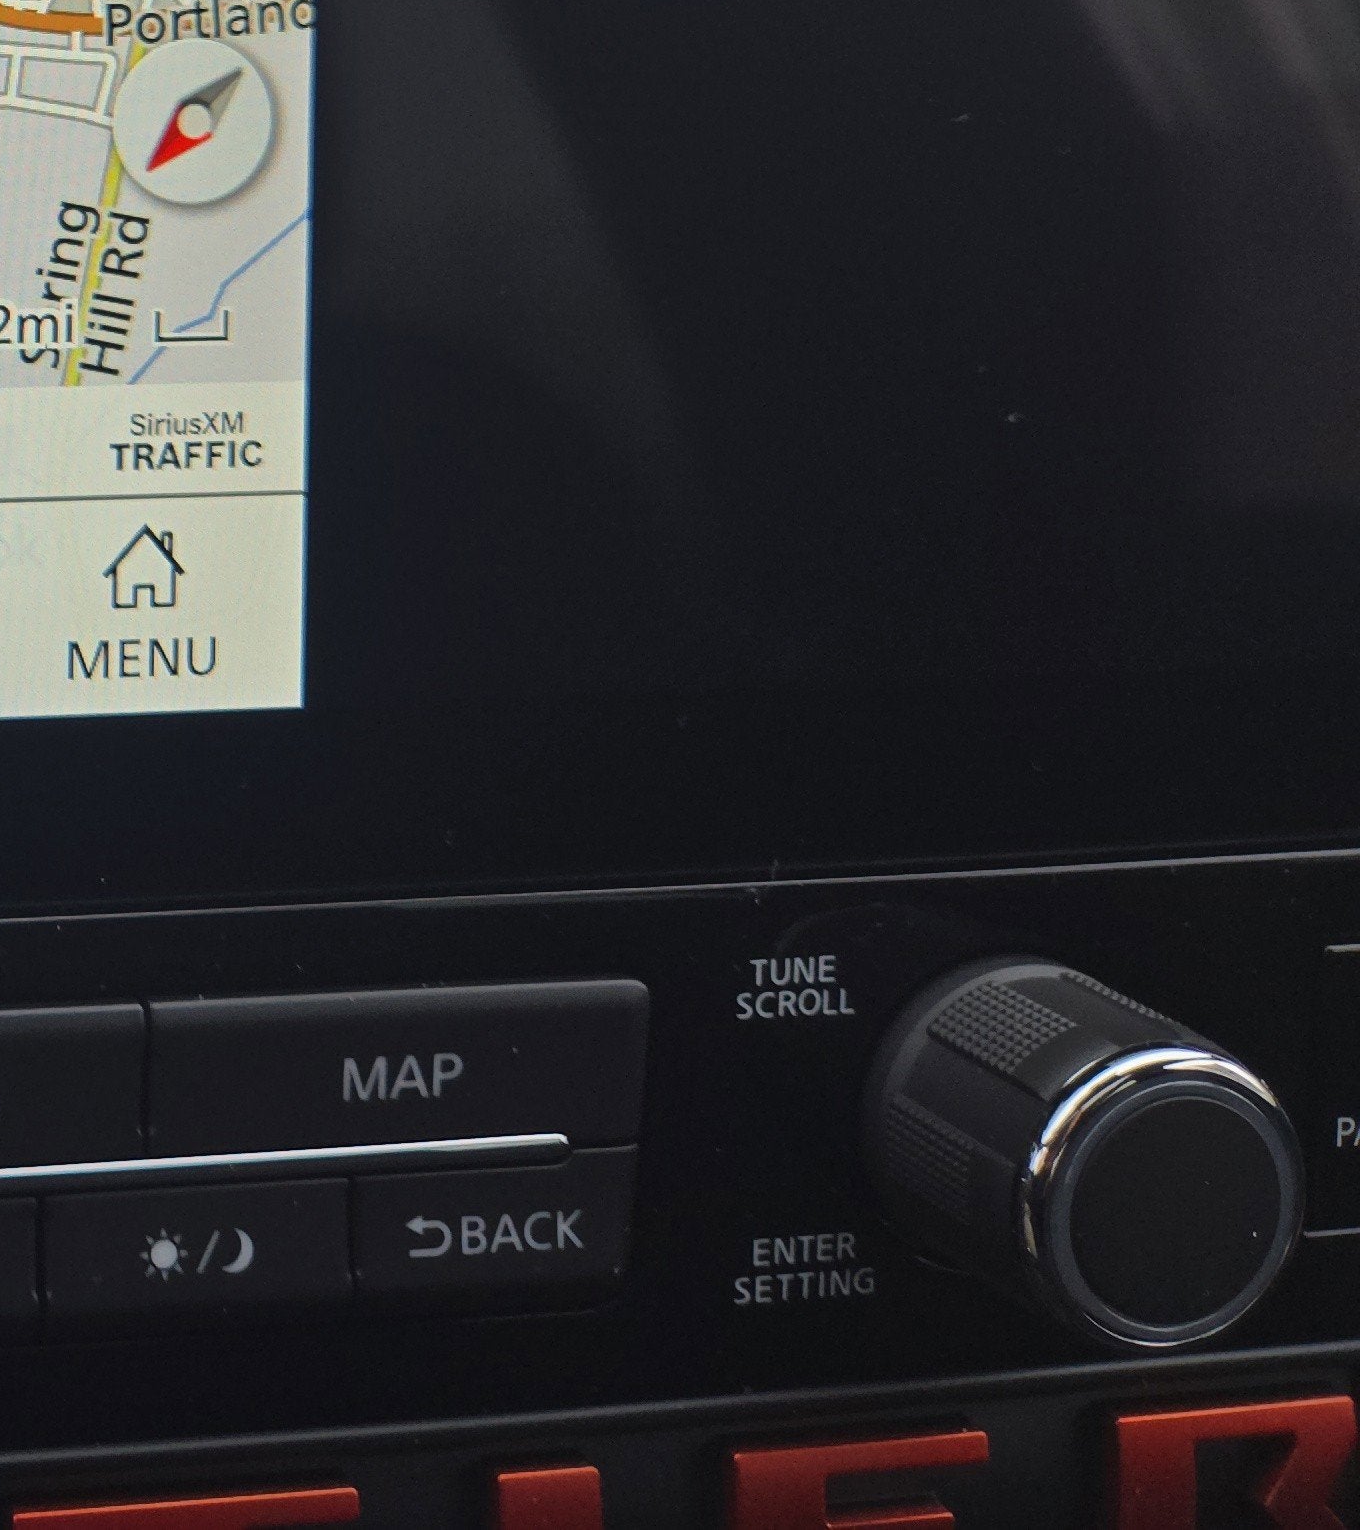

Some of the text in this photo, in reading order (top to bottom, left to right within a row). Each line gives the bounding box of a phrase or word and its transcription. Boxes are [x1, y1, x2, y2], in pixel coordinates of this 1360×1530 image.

[17, 200, 101, 370] Sring
[78, 210, 151, 376] Hill Rd
[129, 411, 245, 437] SiriusXM
[109, 439, 264, 472] TRAFFIC
[66, 634, 218, 682] MENU
[749, 956, 837, 985] TUNE
[735, 988, 855, 1021] SCROLL
[341, 1051, 465, 1102] MAP
[460, 1210, 585, 1256] BACK
[751, 1233, 856, 1268] ENTER
[733, 1267, 875, 1305] SETTING
